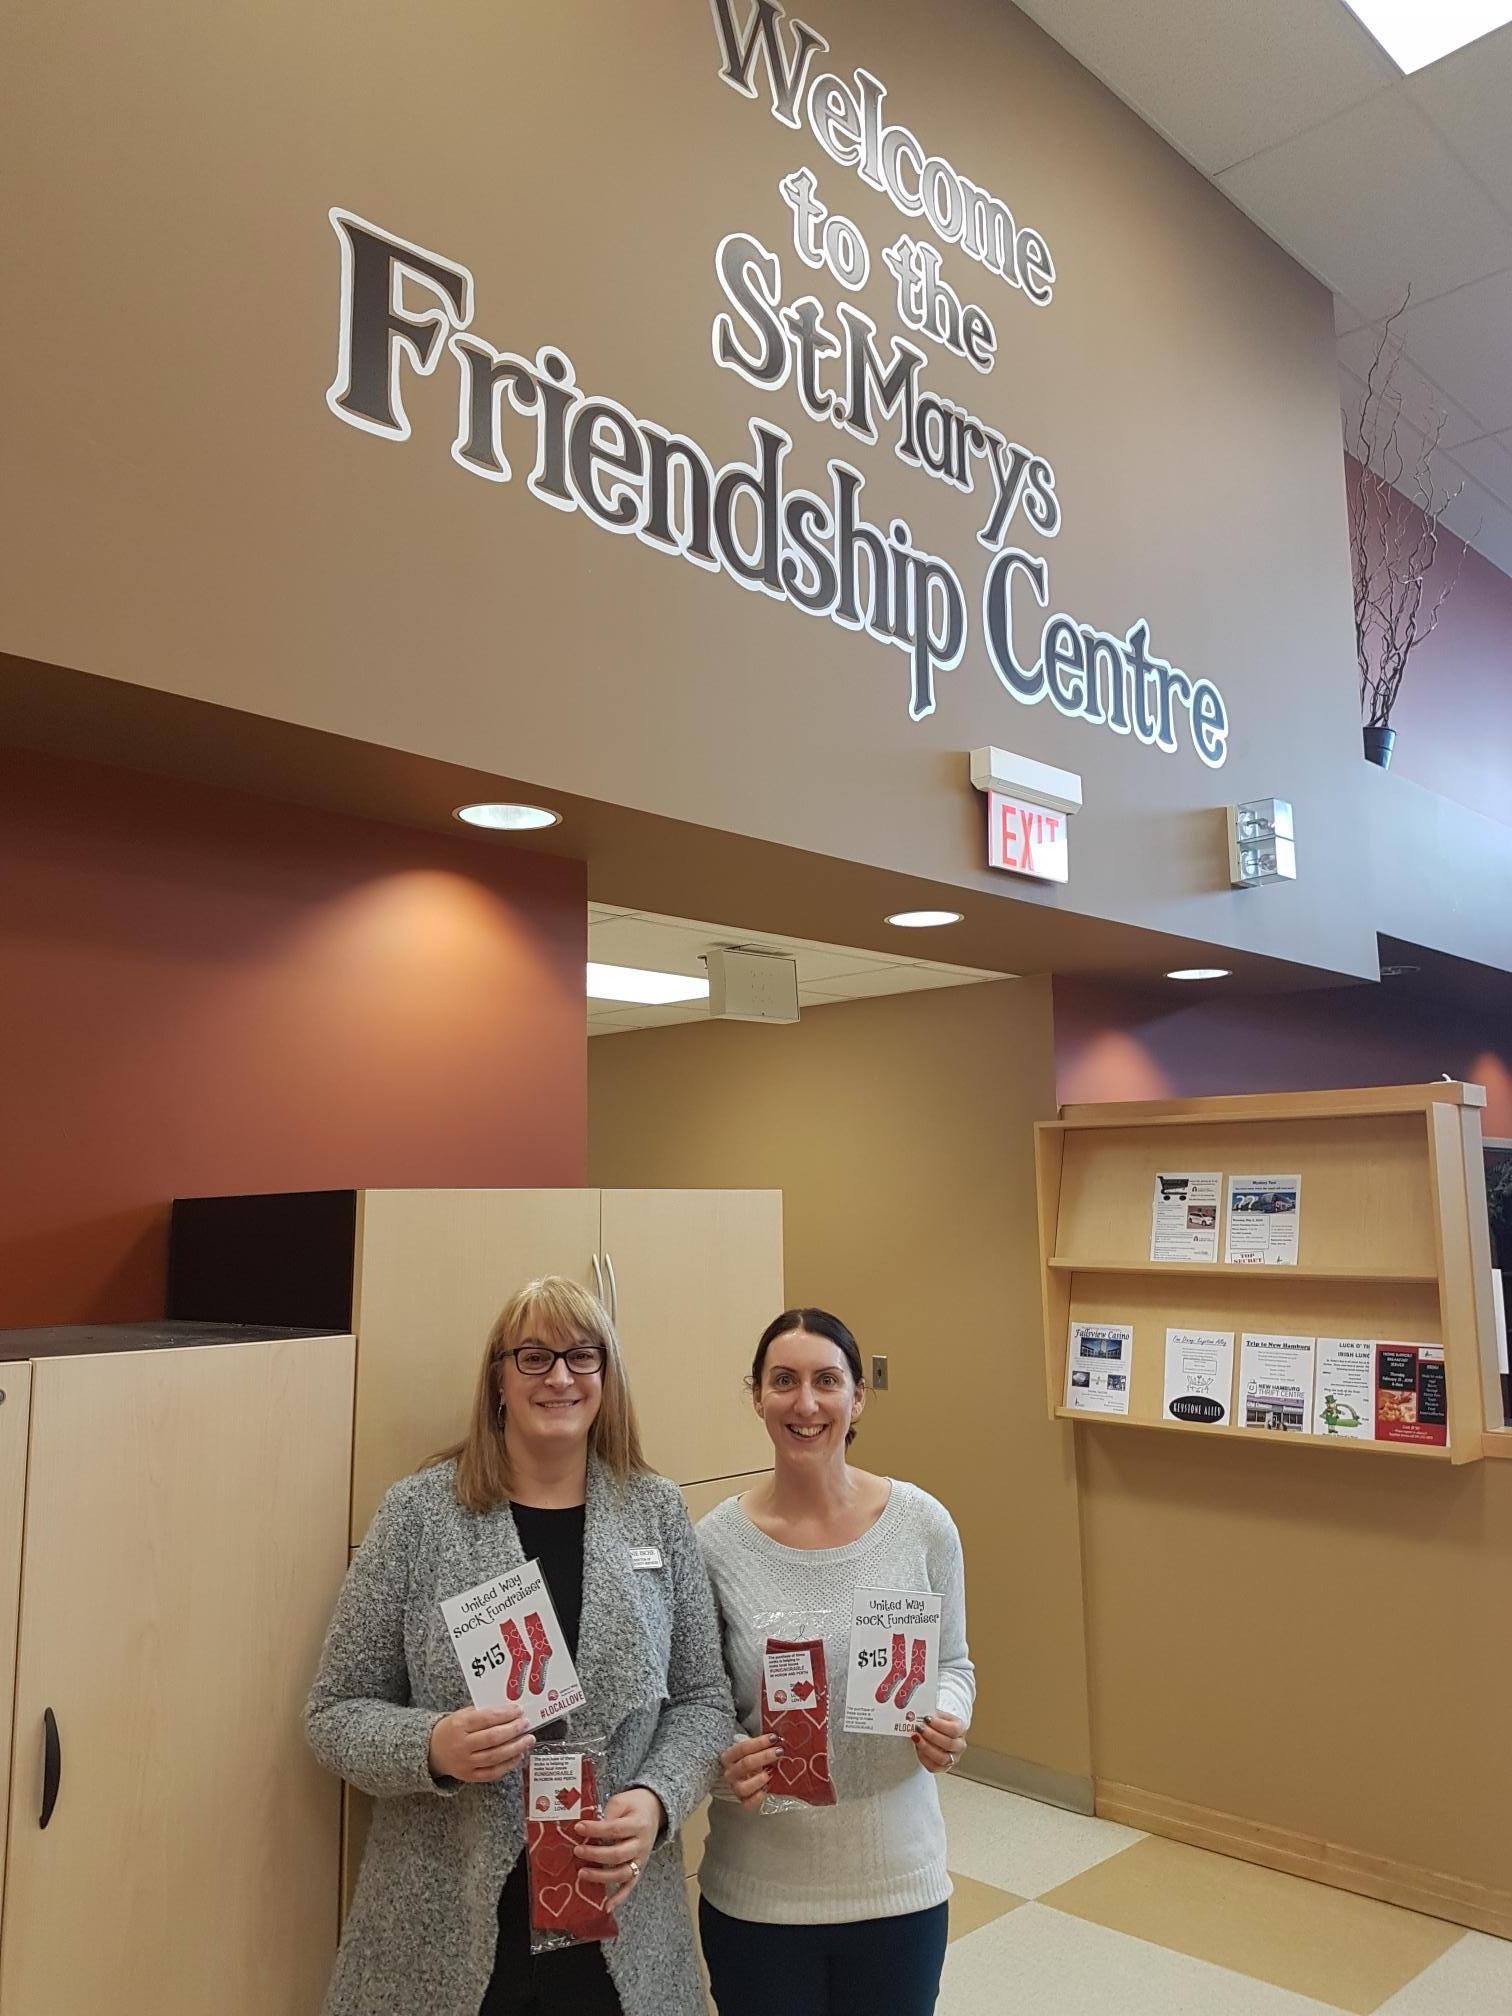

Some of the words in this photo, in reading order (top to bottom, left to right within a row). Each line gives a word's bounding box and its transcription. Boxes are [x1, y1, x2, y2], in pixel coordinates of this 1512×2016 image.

[708, 0, 1056, 307] Welcome
[779, 167, 870, 291] to
[882, 234, 998, 374] the
[325, 206, 968, 722] Friendship
[983, 547, 1229, 769] Centre
[1001, 804, 1060, 872] EXIT
[1282, 1342, 1311, 1350] Hamburg
[1173, 1402, 1201, 1415] KEYSTONE
[1203, 1405, 1221, 1417] ALLEY
[460, 1588, 498, 1613] United
[499, 1574, 522, 1593] Way
[487, 1579, 542, 1619] Fundraiser
[869, 1599, 902, 1611] United
[905, 1598, 925, 1611] Way
[887, 1612, 939, 1625] Fundraiser
[471, 1643, 506, 1678] $15
[858, 1648, 888, 1669] $15
[540, 1690, 584, 1719] #LOCALLOVE
[895, 1722, 916, 1732] #LOCA
